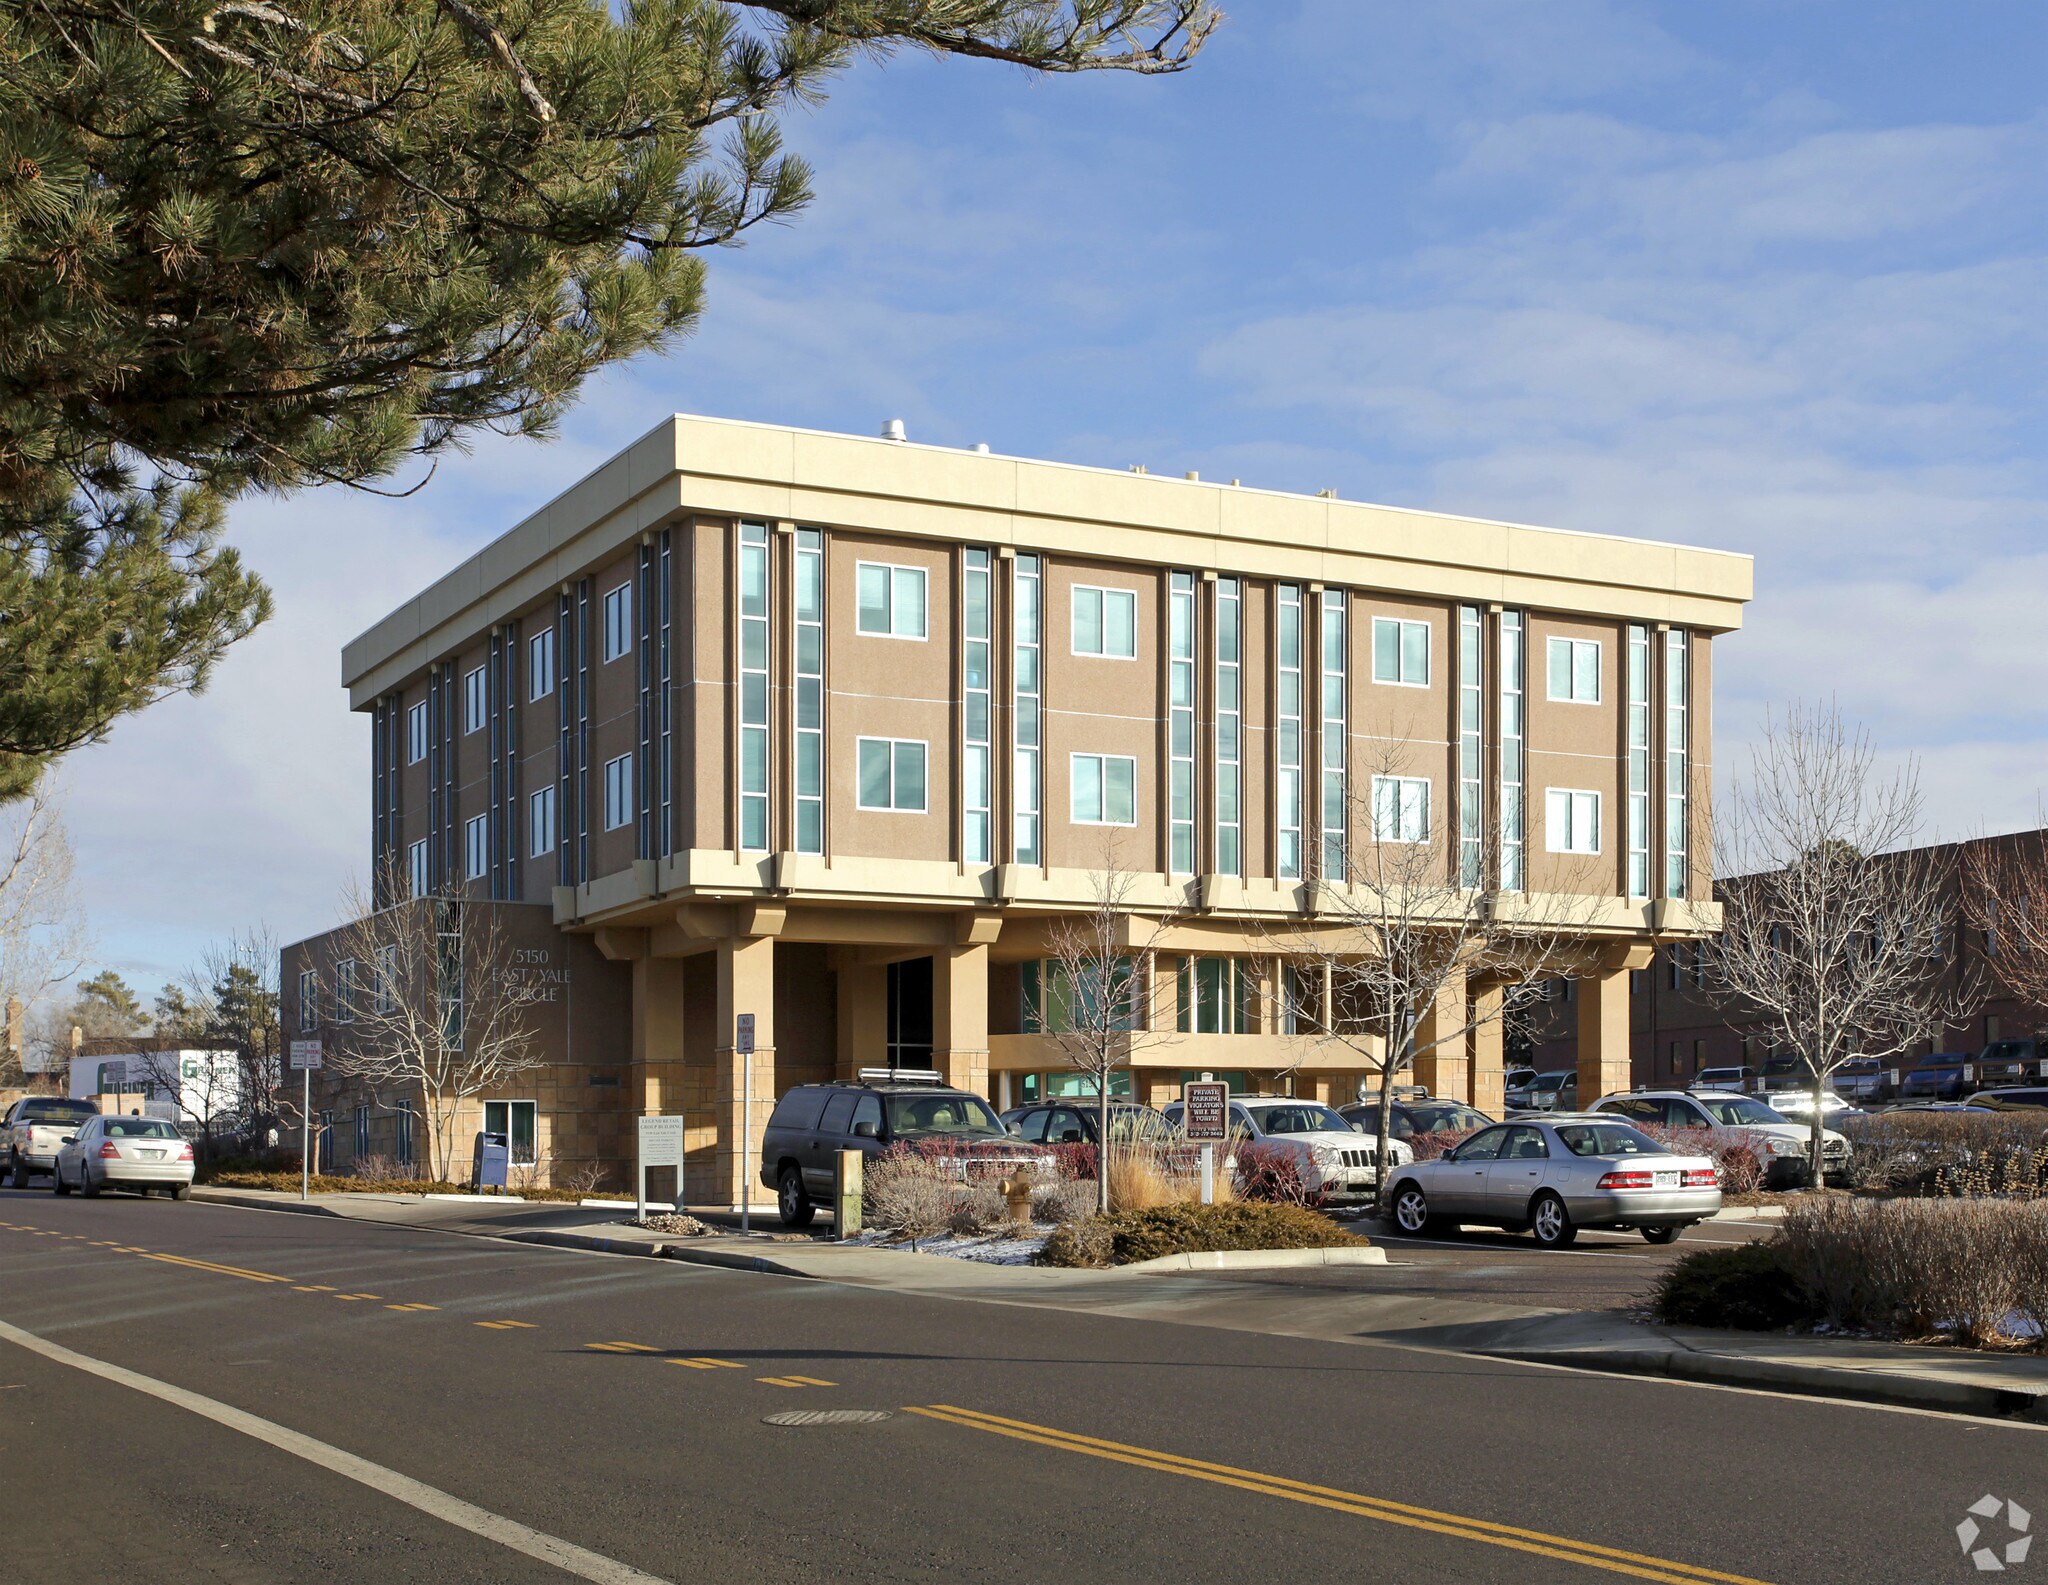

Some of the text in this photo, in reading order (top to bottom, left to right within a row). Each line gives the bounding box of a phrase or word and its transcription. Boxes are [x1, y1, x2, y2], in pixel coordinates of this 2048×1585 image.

[516, 949, 549, 964] 5150
[492, 967, 572, 984] EAST YALE
[507, 986, 557, 1002] CIRCLE
